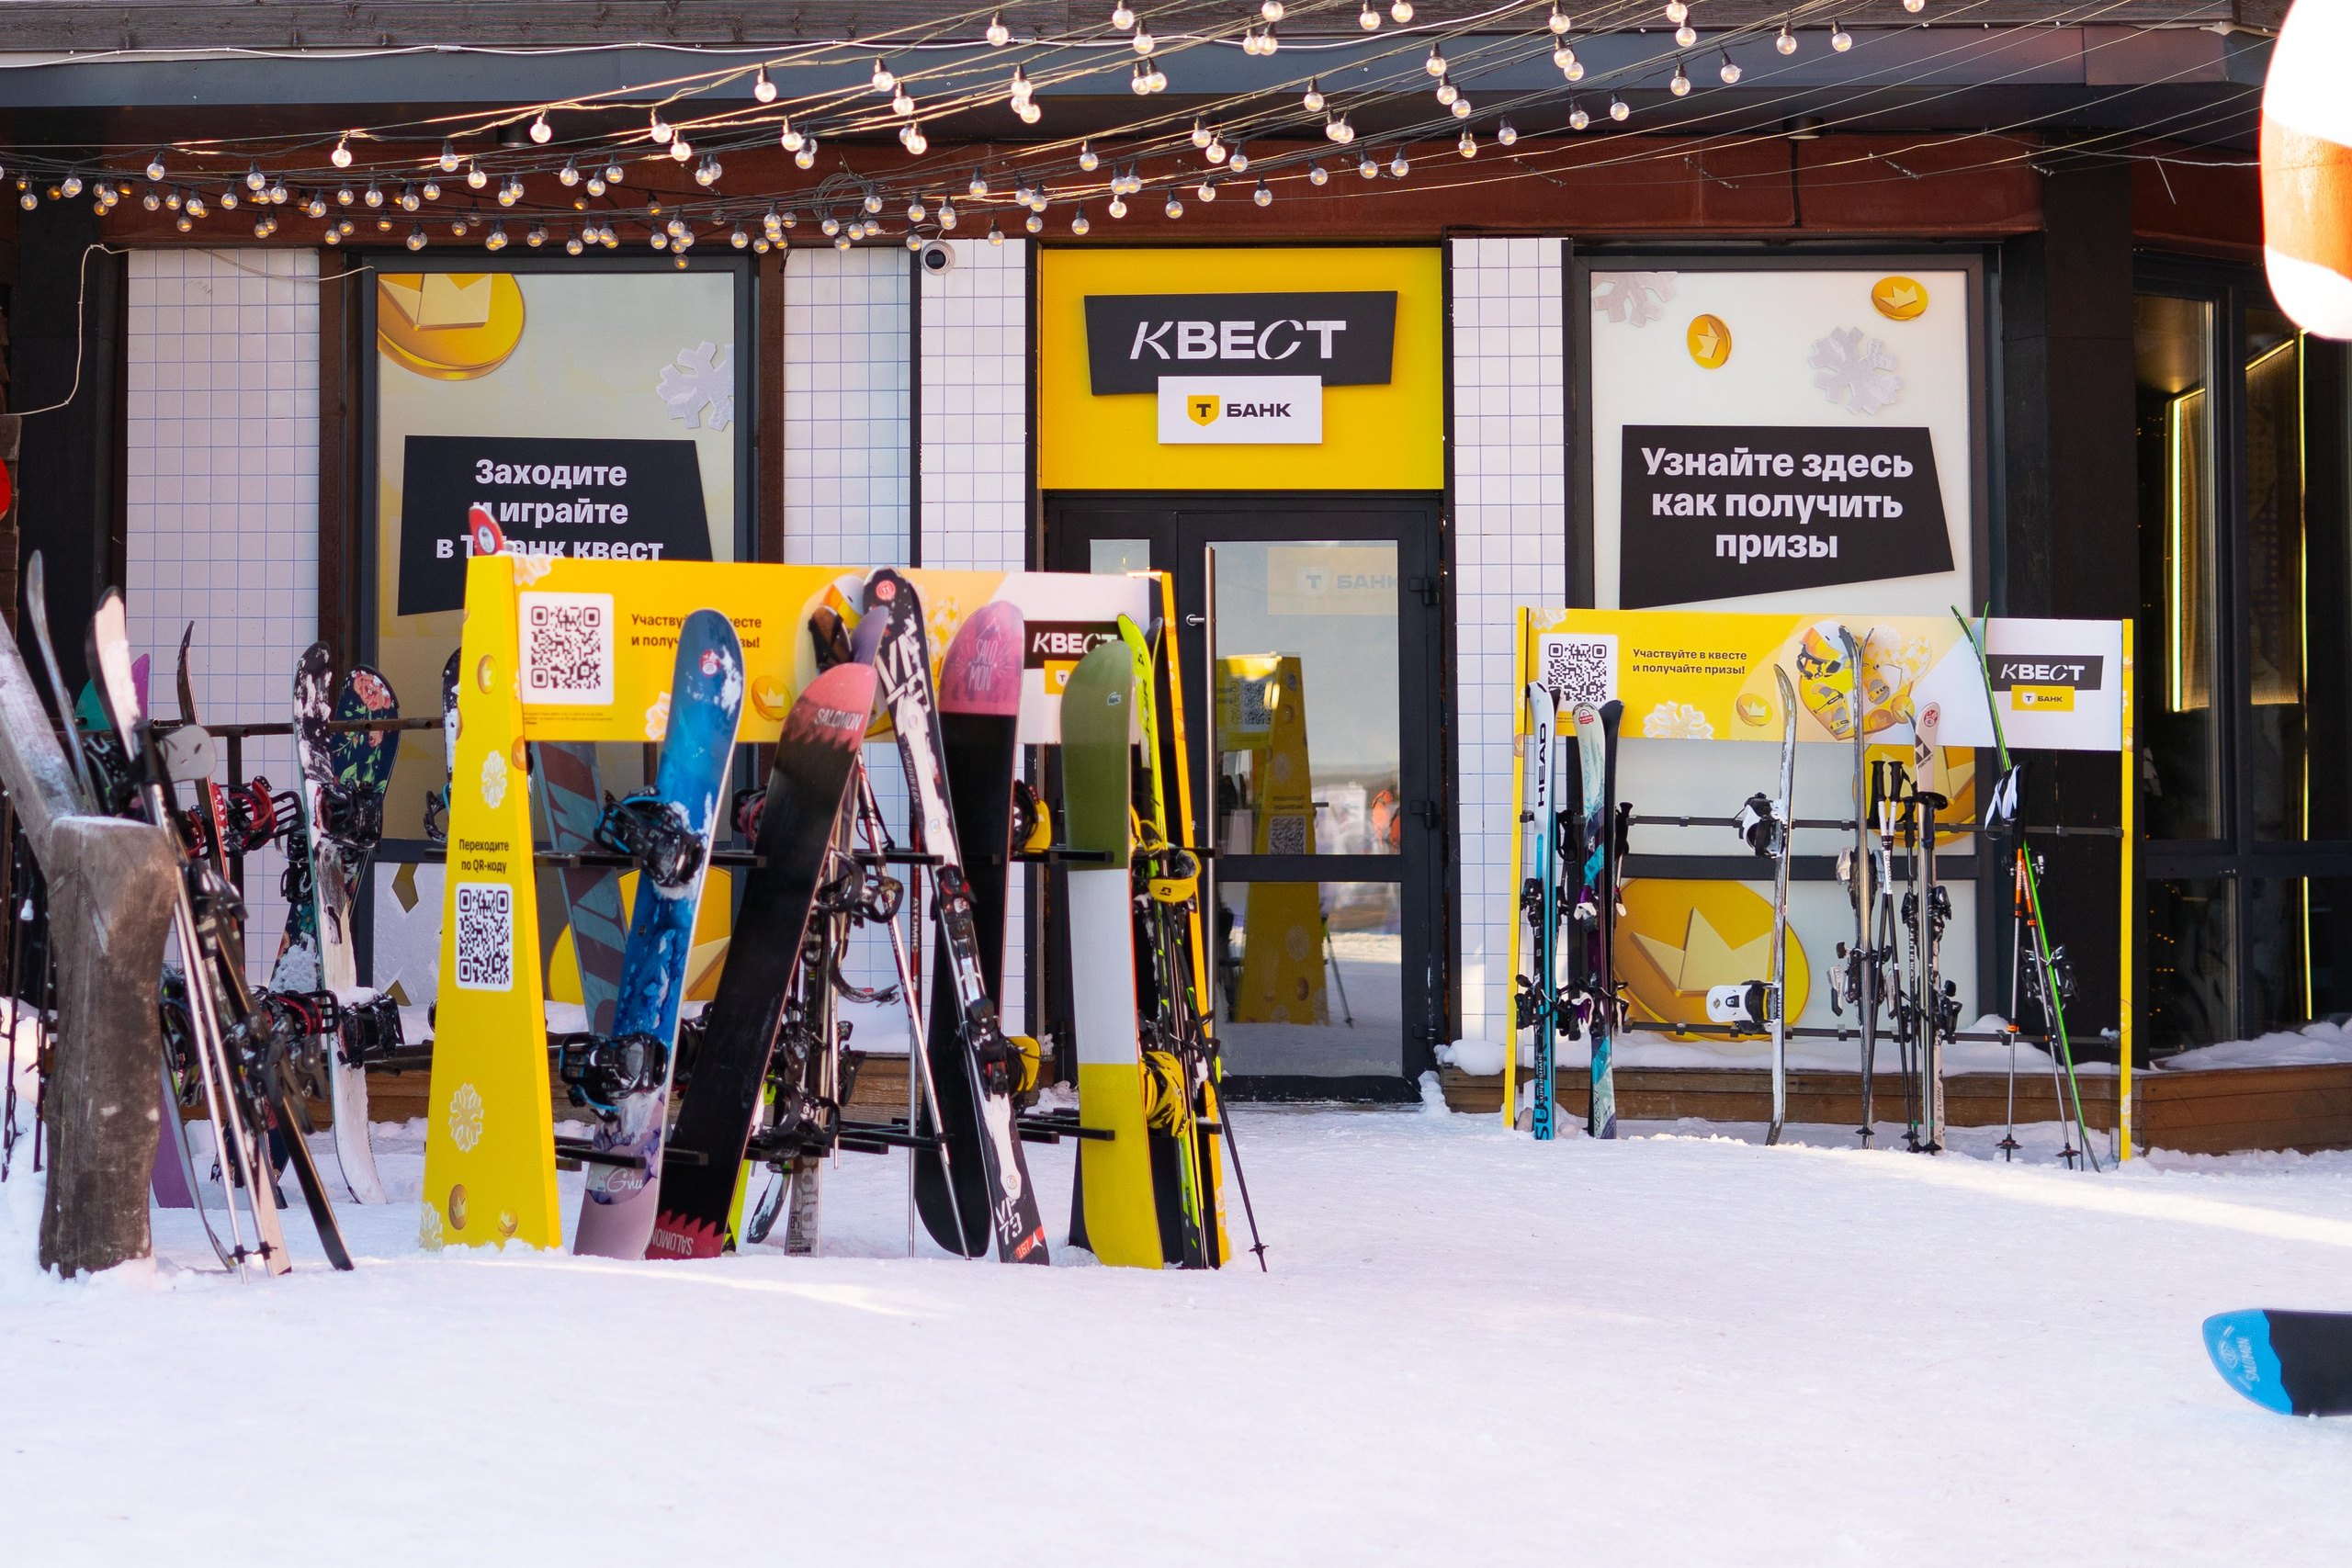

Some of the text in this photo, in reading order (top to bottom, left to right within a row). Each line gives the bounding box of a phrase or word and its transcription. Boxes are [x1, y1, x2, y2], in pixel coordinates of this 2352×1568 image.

[1129, 319, 1347, 360] КВЕСТ
[1227, 403, 1292, 418] БАНК
[475, 458, 628, 490] Заходите
[1640, 446, 1915, 482] Узнайте здесь
[500, 498, 629, 529] играйте
[1652, 492, 1905, 525] как получить
[436, 538, 454, 558] в
[572, 542, 664, 561] квест
[1715, 534, 1838, 564] призы
[1632, 648, 1747, 661] Участвуйте в квесте
[1632, 663, 1746, 676] и получайте призы!
[2000, 663, 2086, 682] КВЕСТ
[2037, 694, 2064, 703] БАНК
[814, 707, 864, 731] SALOMON
[1537, 722, 1547, 807] HEAD
[458, 839, 510, 853] Переходите
[461, 859, 507, 874] по QR-коду
[607, 1168, 643, 1192] Gnu
[650, 1227, 694, 1256] SALOMON
[1016, 1238, 1030, 1259] 167
[2236, 1337, 2260, 1382] SALOMON
